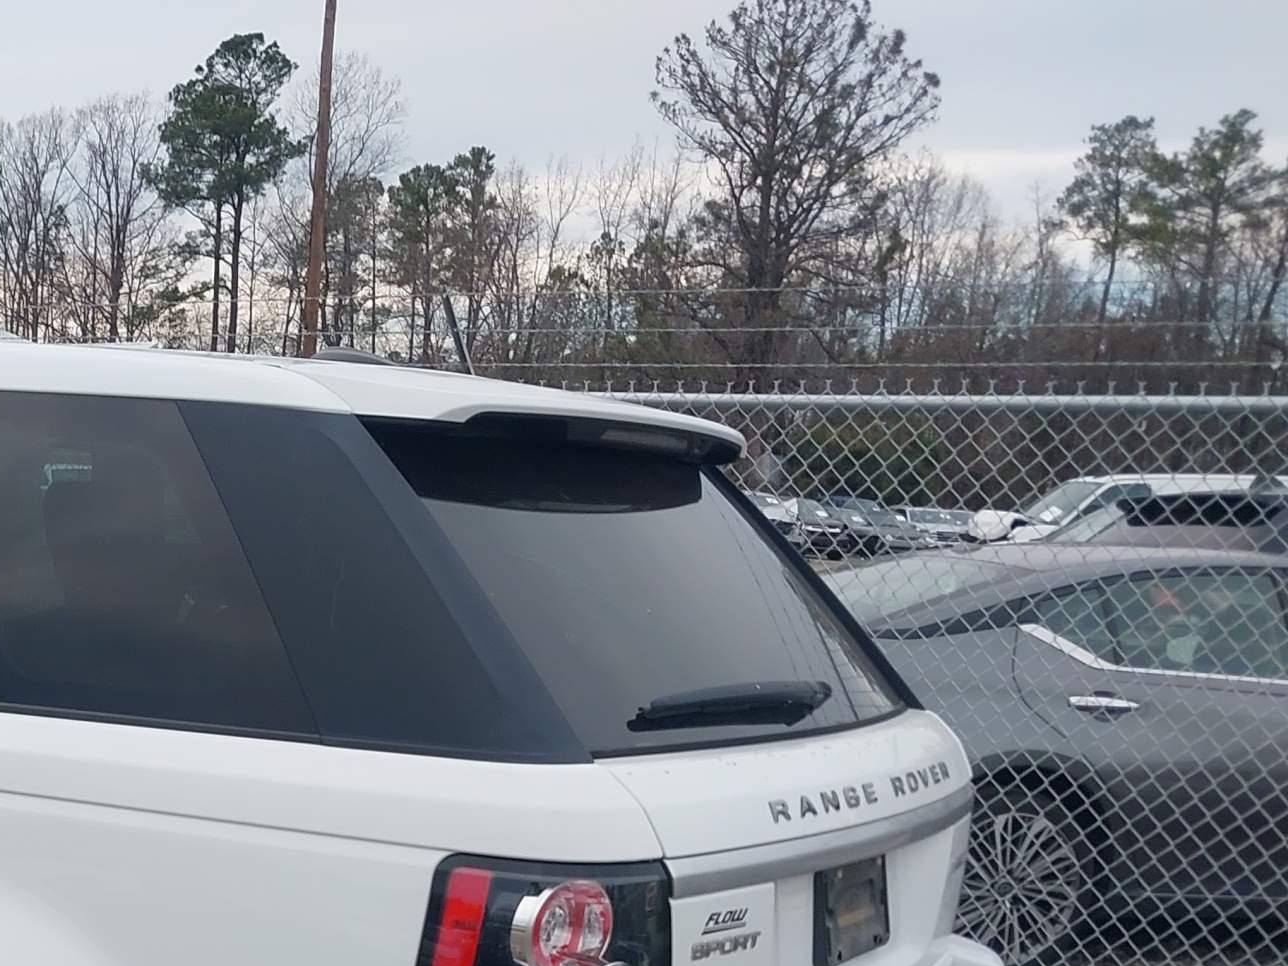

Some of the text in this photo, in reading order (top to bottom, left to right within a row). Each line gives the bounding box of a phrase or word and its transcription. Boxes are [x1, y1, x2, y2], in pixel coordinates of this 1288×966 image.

[768, 761, 951, 824] RANGE ROVER
[691, 931, 761, 961] SPORT
